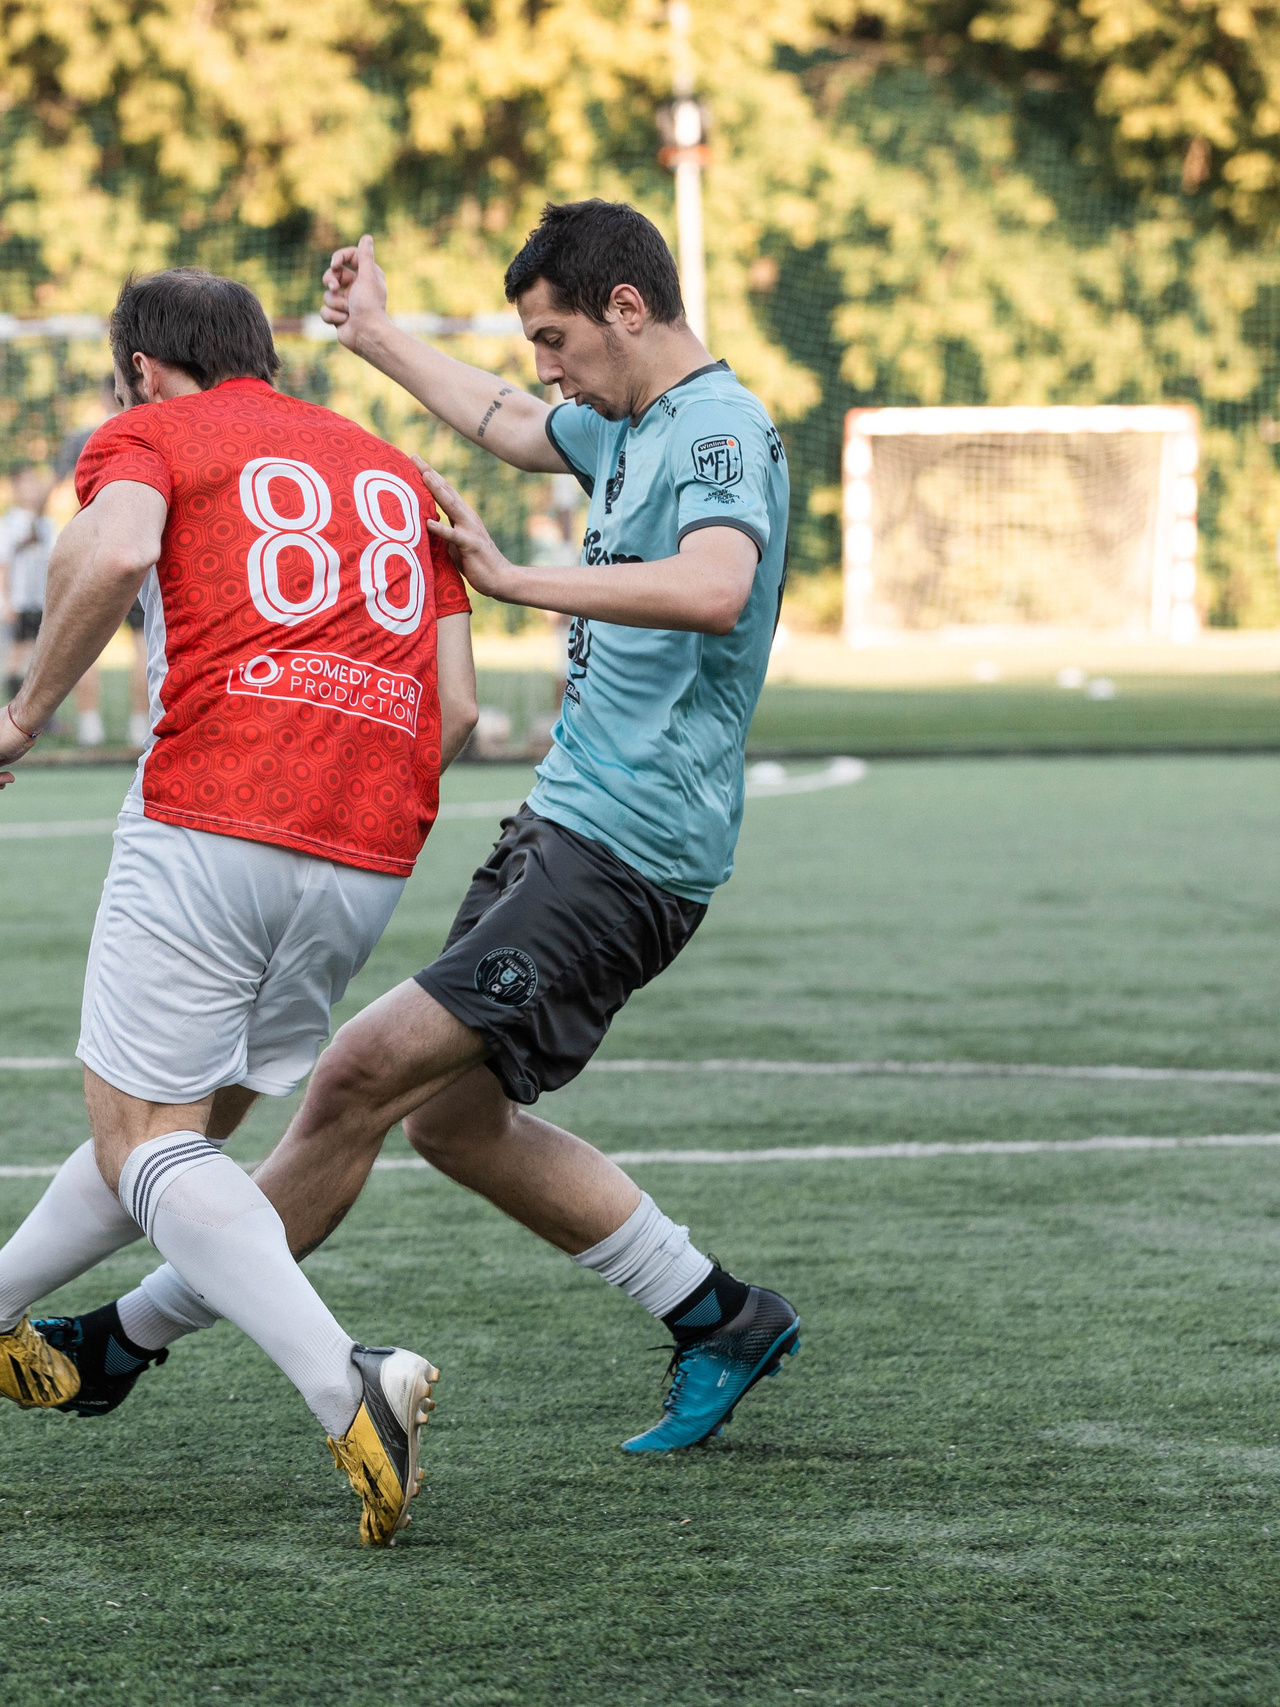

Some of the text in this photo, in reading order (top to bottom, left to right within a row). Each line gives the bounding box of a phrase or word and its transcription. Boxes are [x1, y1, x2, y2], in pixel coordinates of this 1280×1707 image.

[698, 448, 738, 482] MFL
[699, 440, 726, 450] Winline
[238, 456, 426, 635] 88
[290, 657, 416, 704] COMEDY CLUB
[290, 675, 415, 726] PRODUCTION
[486, 949, 536, 997] MOSCOW FOOTBALL CLUB
